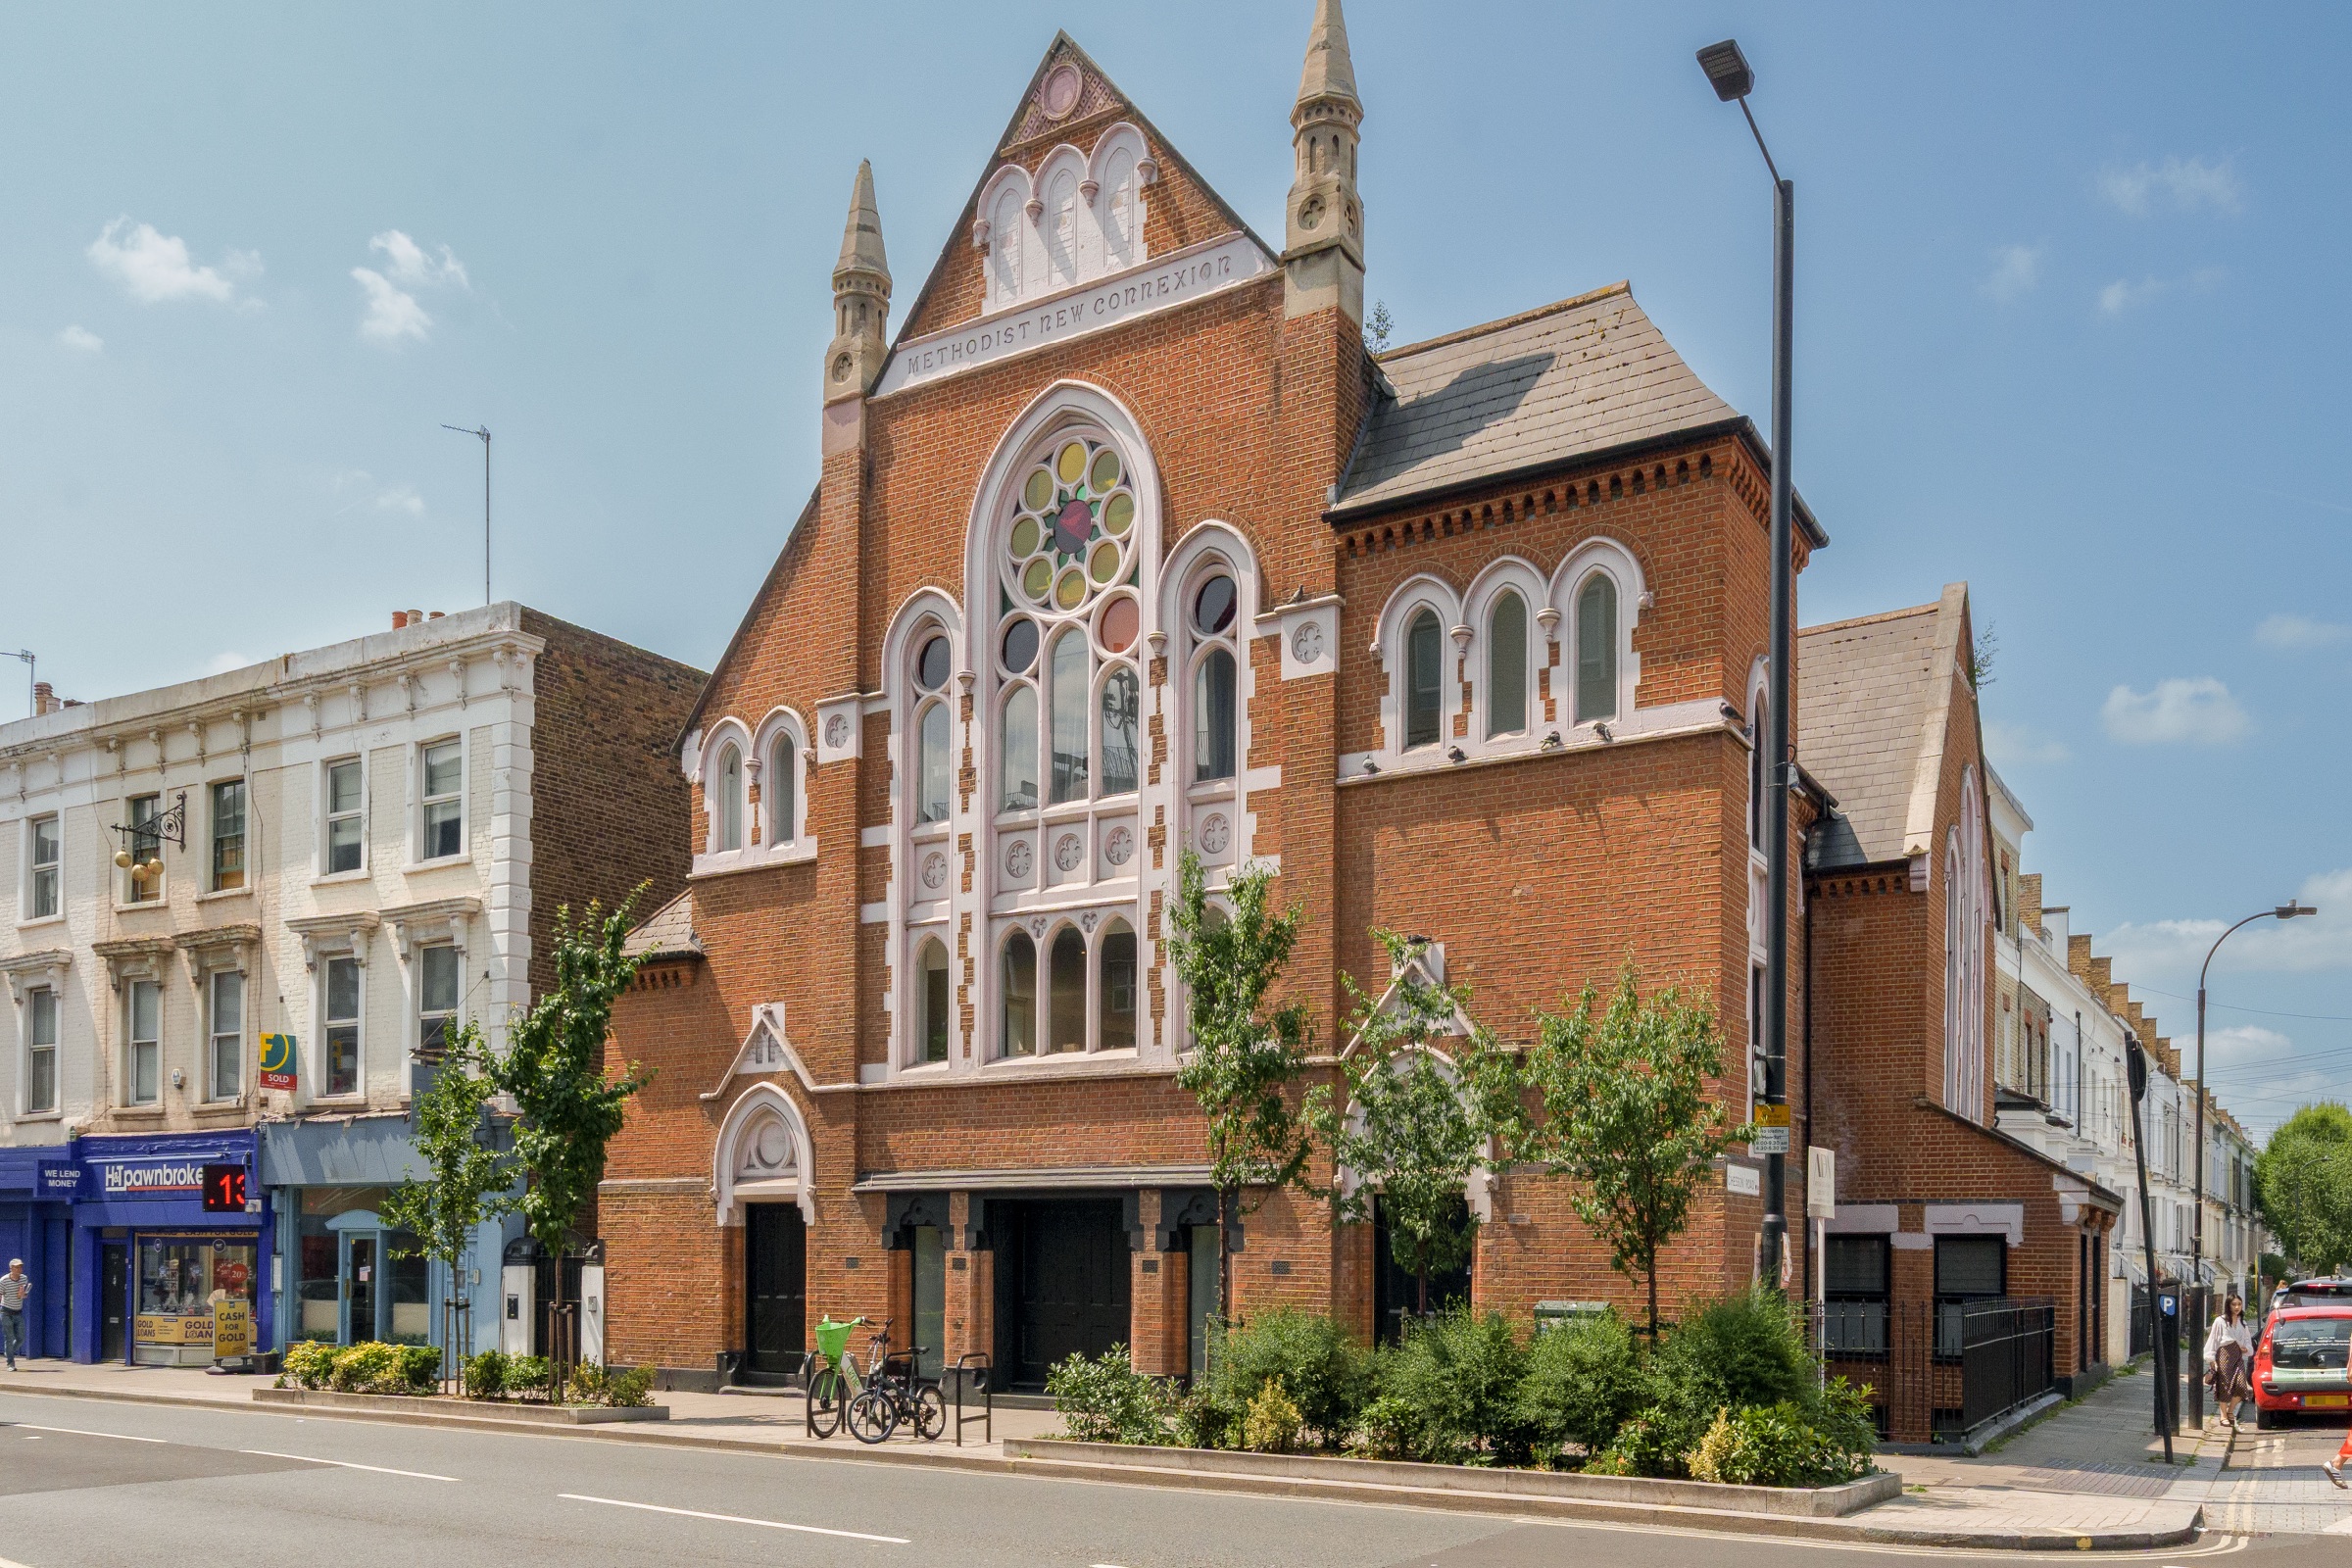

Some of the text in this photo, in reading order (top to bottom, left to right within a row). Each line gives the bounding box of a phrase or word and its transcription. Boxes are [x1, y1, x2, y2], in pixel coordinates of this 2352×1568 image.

[907, 256, 1231, 374] METHODIST NEW CONNEXION
[268, 1074, 289, 1083] SOLD
[45, 1169, 58, 1178] WE
[48, 1179, 77, 1188] MONEY
[2163, 1298, 2174, 1312] P
[219, 1312, 245, 1321] CASH
[184, 1320, 214, 1330] GOLD
[137, 1329, 156, 1338] LOANS
[219, 1333, 246, 1343] GOLD
